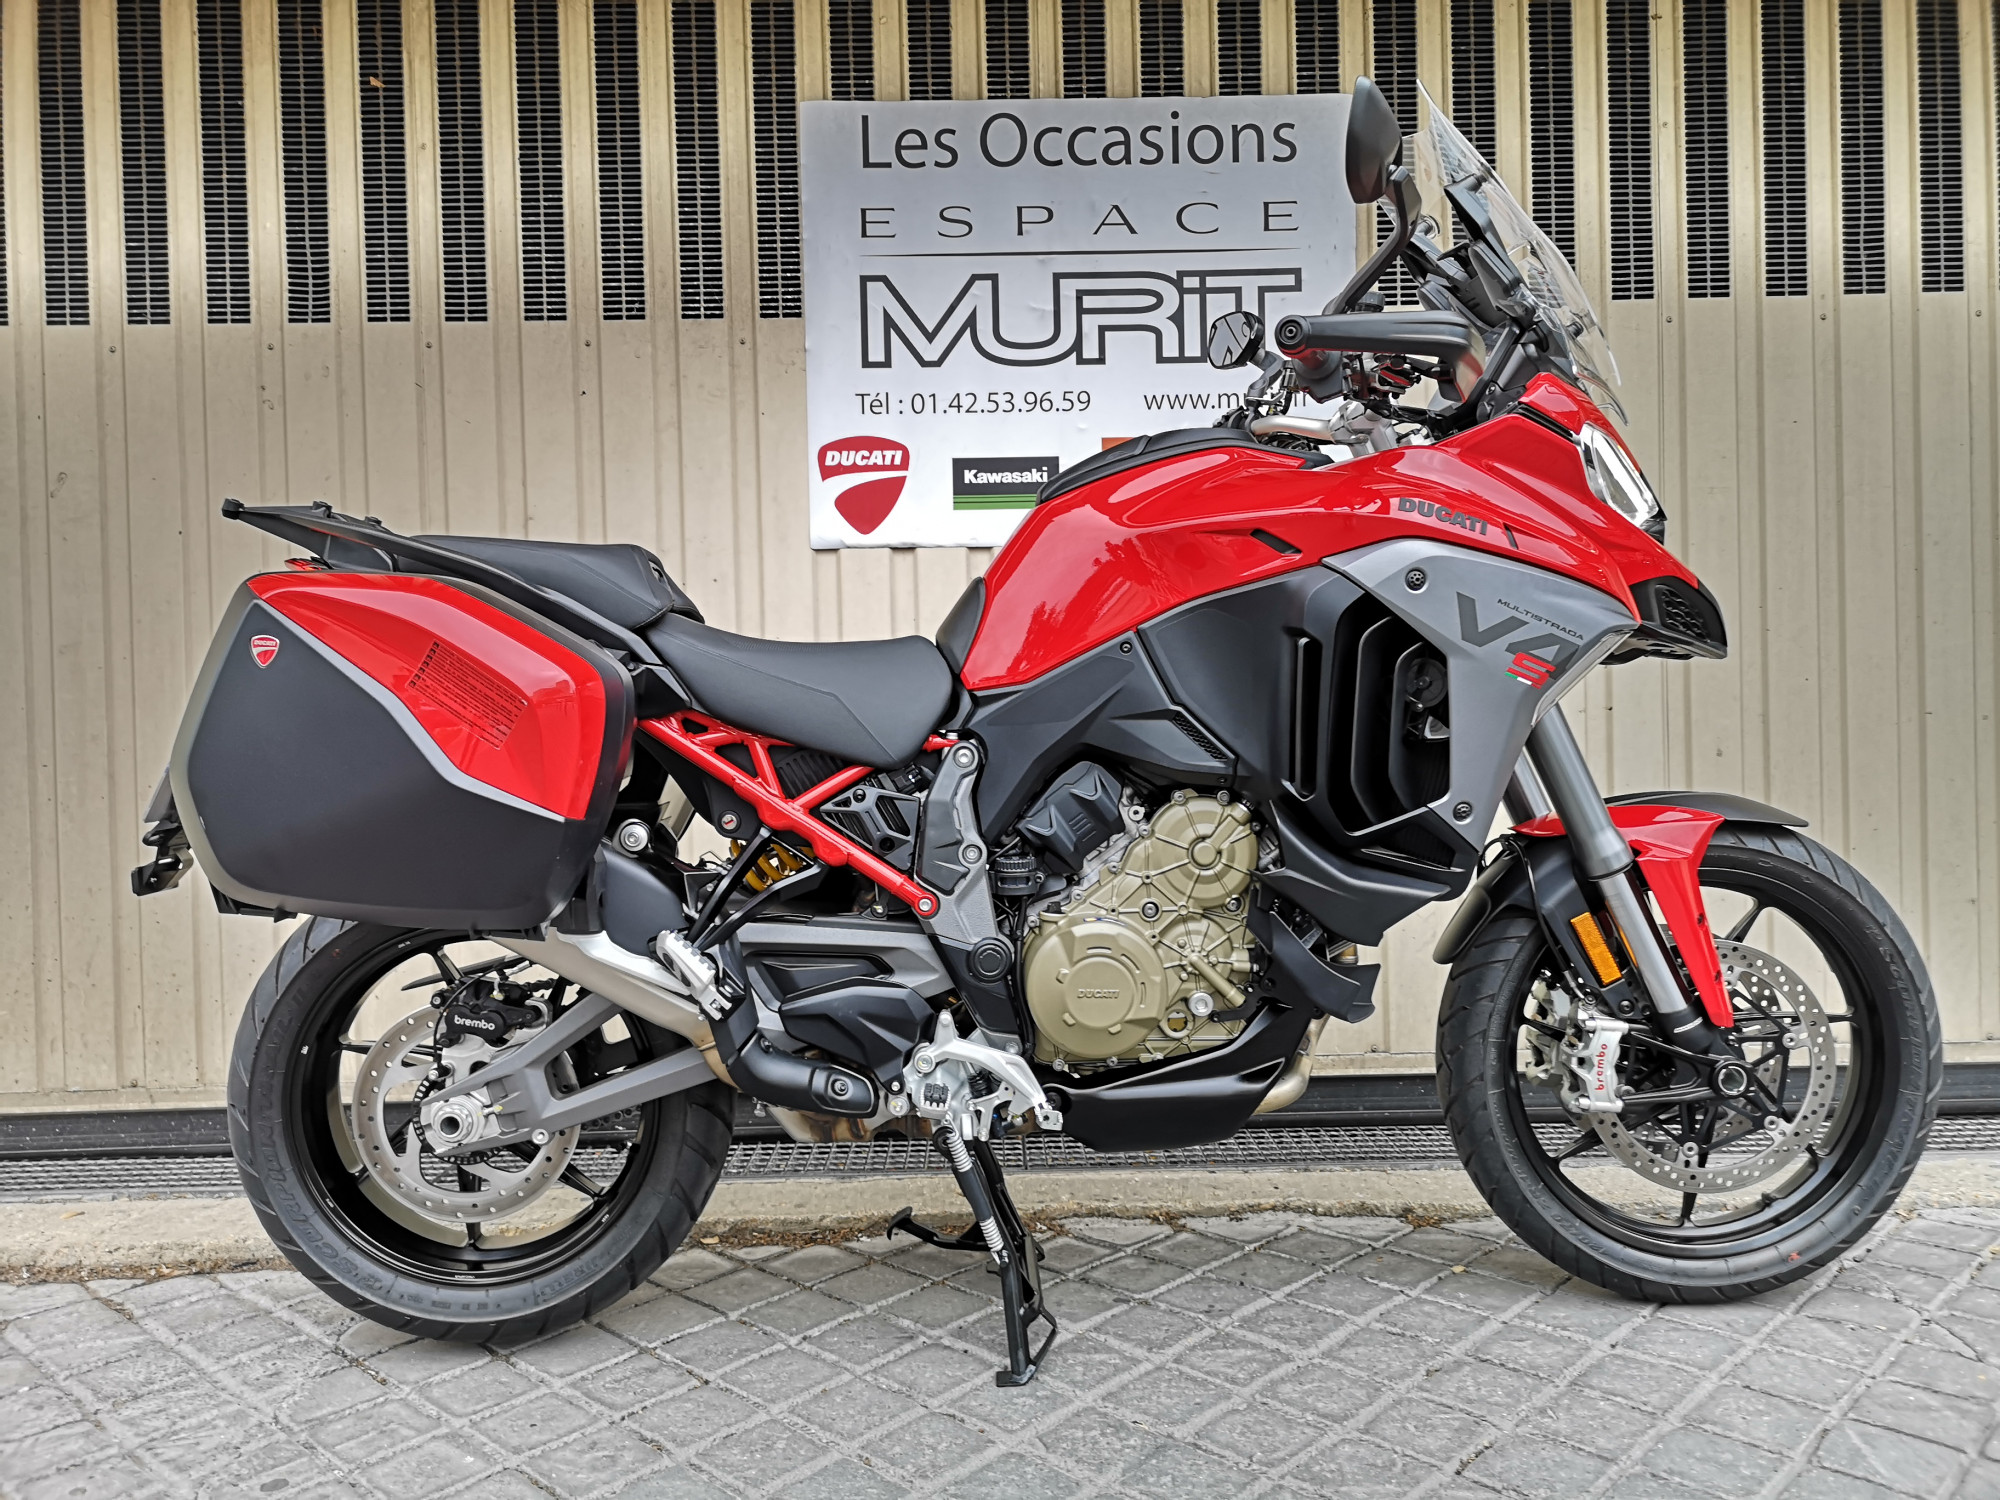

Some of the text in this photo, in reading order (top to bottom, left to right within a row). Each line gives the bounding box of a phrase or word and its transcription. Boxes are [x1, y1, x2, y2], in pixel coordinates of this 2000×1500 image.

[861, 110, 1298, 169] Les Occasions
[860, 200, 1300, 239] ESPACE
[854, 392, 890, 415] Tél
[910, 390, 1092, 415] 01.42.53.96.59
[824, 450, 903, 467] DUCATI
[963, 467, 1049, 484] Kawasaki
[1397, 496, 1489, 537] DUCATI
[1455, 590, 1581, 687] V4 S
[1497, 598, 1585, 641] MULTISTRADA
[1076, 988, 1120, 1000] DUCATI
[453, 1014, 496, 1031] brembo
[1594, 1043, 1608, 1091] brembo
